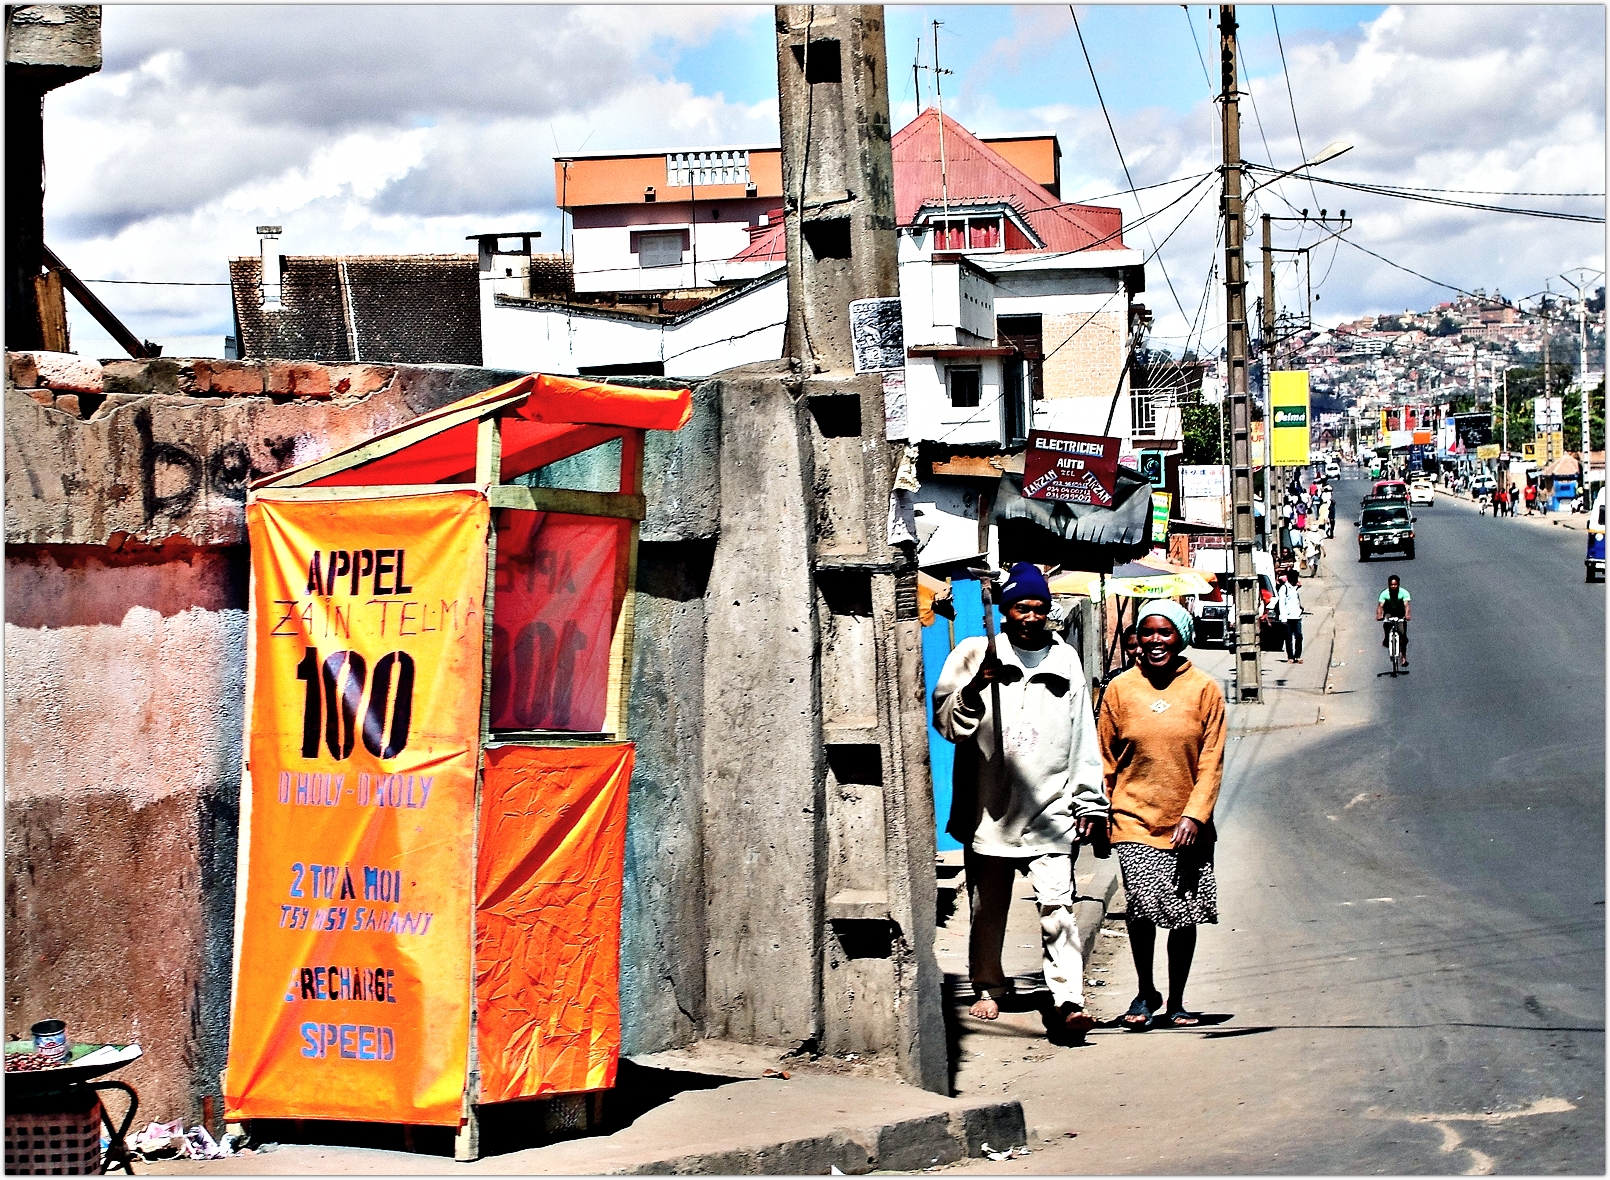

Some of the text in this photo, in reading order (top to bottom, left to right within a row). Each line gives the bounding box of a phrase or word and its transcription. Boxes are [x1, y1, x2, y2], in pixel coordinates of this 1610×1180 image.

[1035, 438, 1104, 456] ELECTRICIEN
[1056, 458, 1085, 470] AUTO
[1023, 469, 1059, 498] TARZAN
[1081, 470, 1112, 503] TARZAN
[305, 549, 413, 596] APPEL
[365, 597, 476, 639] TELMA
[296, 646, 416, 761] 100
[290, 861, 305, 898] 2
[363, 865, 401, 903] MOI
[280, 905, 310, 929] TSY
[300, 1022, 396, 1061] SPEED
